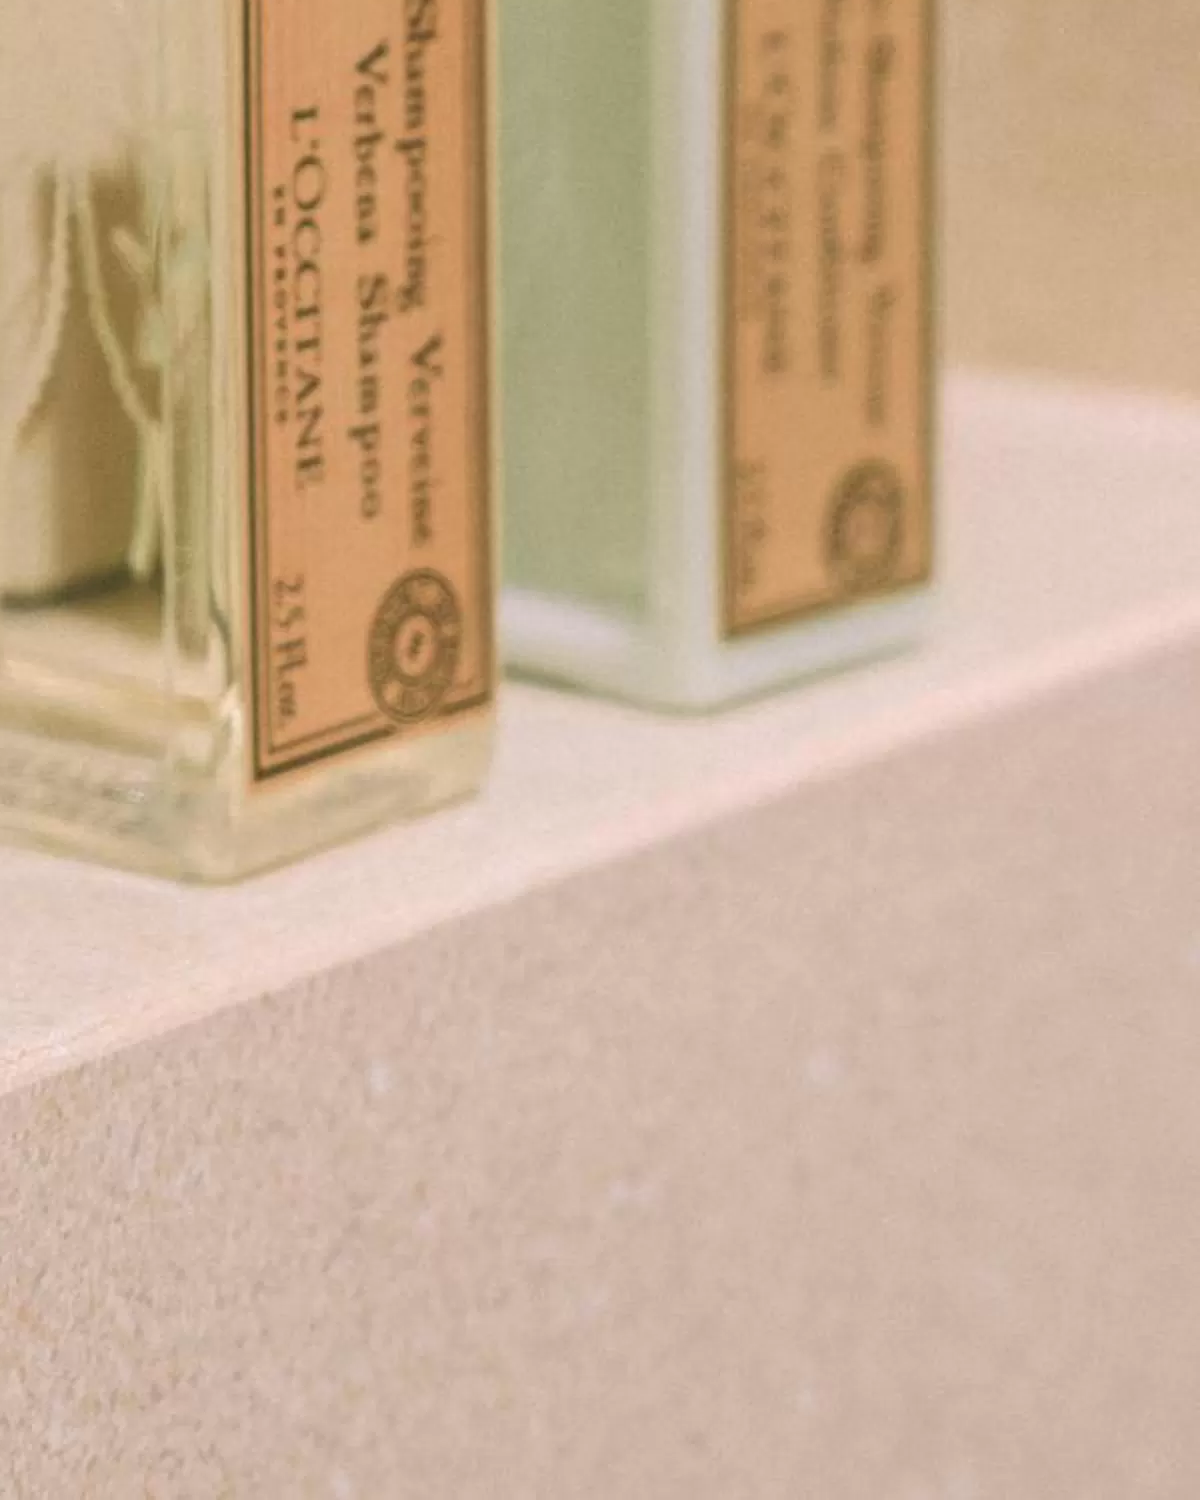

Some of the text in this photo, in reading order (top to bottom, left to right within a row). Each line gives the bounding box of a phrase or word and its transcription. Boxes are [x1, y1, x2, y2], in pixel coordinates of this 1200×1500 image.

[291, 105, 326, 488] L'OCCITANE
[347, 38, 392, 520] Verbena Shampoo
[407, 331, 444, 547] Verveine
